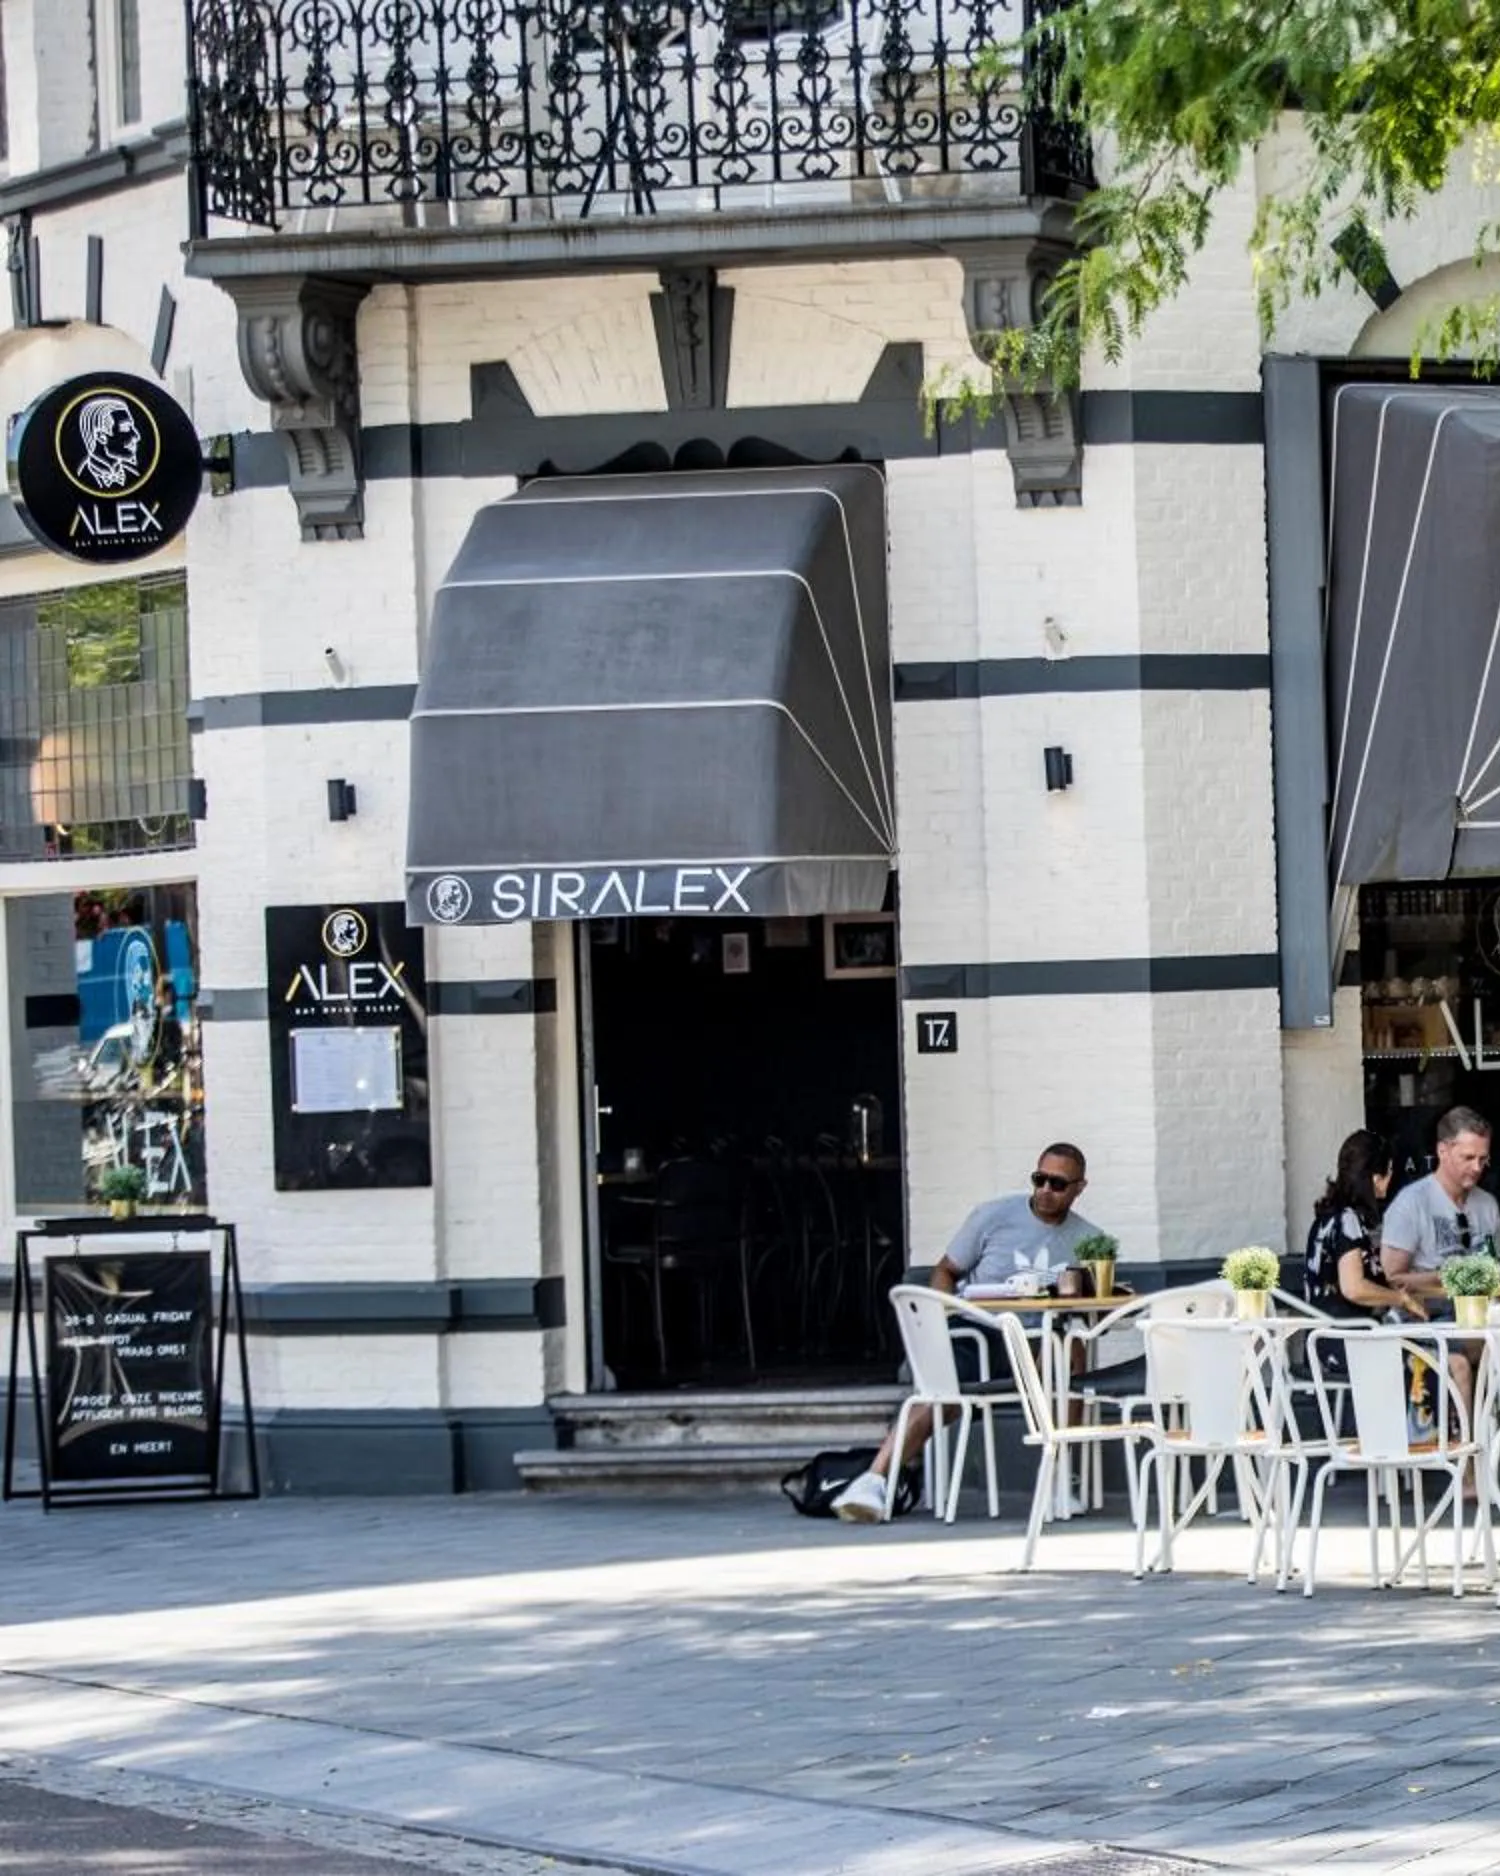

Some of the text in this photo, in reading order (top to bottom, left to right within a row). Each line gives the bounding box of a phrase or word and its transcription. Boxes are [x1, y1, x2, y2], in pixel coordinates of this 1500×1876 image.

[69, 501, 163, 537] ALEX
[285, 961, 405, 1002] ALEX
[1404, 1155, 1438, 1171] AT
[105, 1313, 147, 1324] CASUAL
[152, 1311, 192, 1323] FRIDAY
